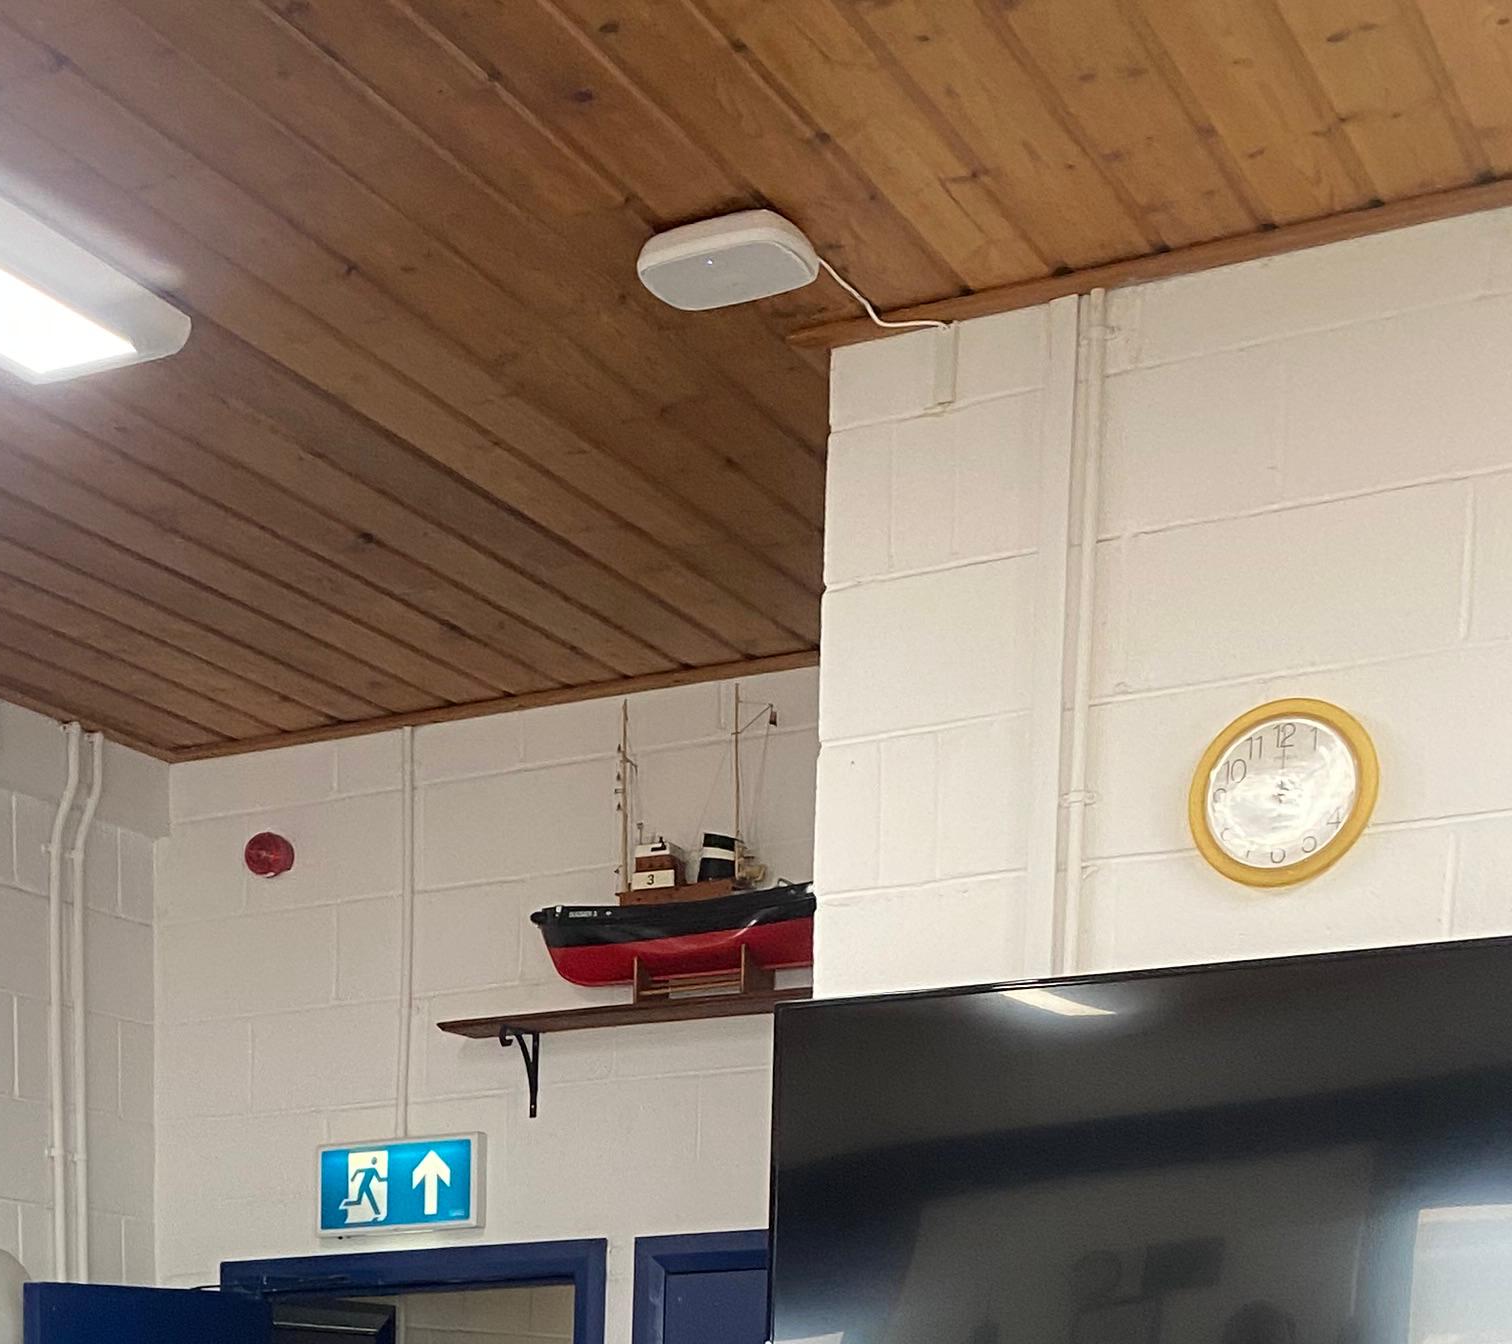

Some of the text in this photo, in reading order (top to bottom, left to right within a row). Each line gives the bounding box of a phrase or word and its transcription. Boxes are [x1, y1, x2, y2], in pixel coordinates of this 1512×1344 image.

[1245, 736, 1263, 760] 11
[1273, 723, 1297, 749] 12
[1310, 727, 1318, 751] 1
[1223, 758, 1247, 785] 10
[646, 874, 655, 886] 3
